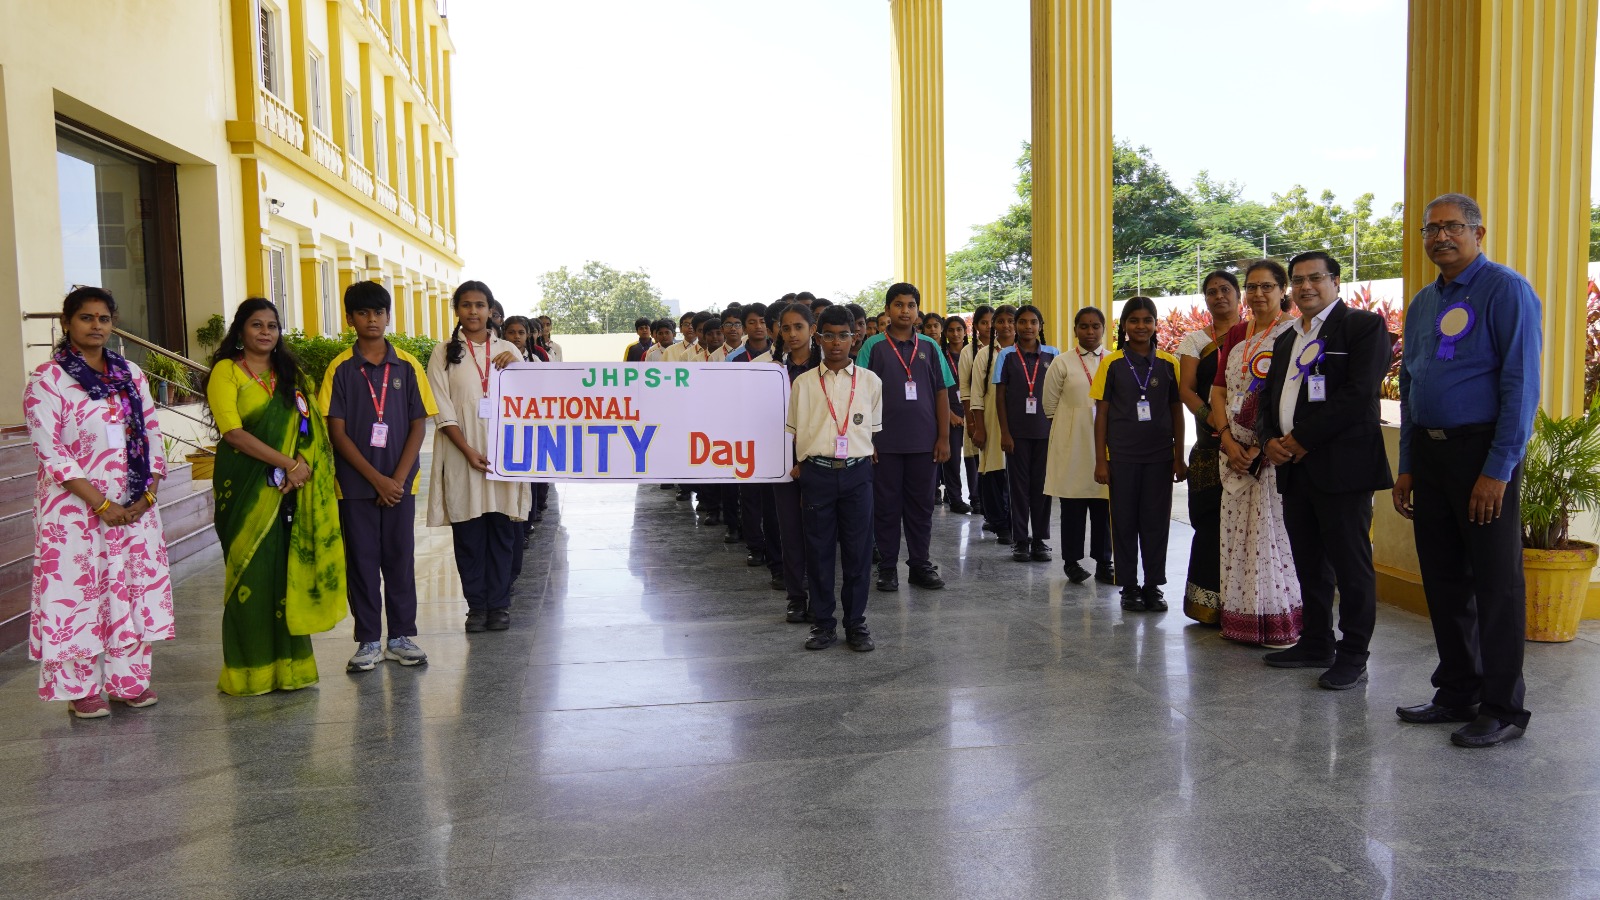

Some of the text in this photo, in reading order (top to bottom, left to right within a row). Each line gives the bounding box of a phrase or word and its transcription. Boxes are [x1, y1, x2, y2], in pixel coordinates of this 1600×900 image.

[581, 367, 691, 388] JHPS-R
[503, 396, 640, 421] NATIONAL
[502, 424, 756, 479] UNITY Day
